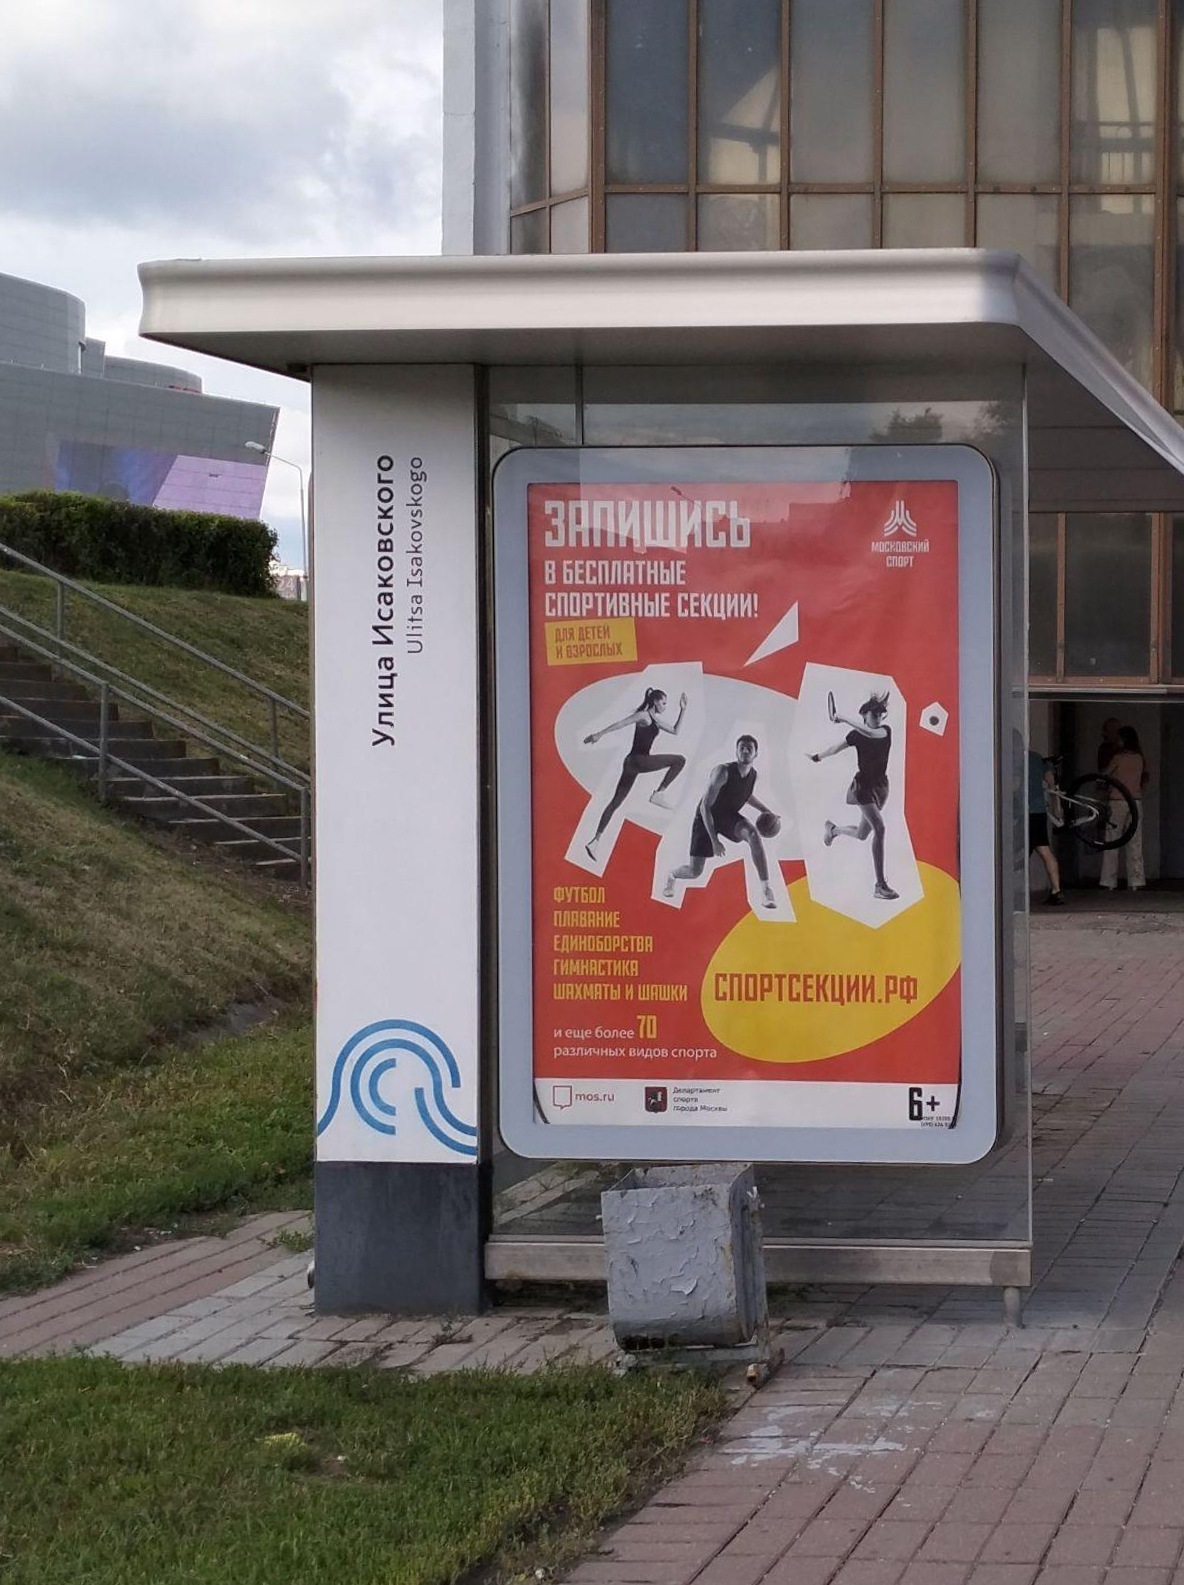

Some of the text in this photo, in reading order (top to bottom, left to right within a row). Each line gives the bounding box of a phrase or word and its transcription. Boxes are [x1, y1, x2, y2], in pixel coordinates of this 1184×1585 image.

[545, 500, 751, 548] ЗАПИШИСЬ
[871, 538, 930, 553] МОСКОВСКИЙ
[406, 457, 427, 654] Ulitsa Isakovskogo
[886, 555, 914, 568] СПОРТ
[545, 560, 687, 585] В БЕСПЛАТНЫЕ
[372, 455, 398, 747] Улица Исаковского
[545, 592, 759, 620] СПОРТИВНЫЕ СЕКЦИИ!
[555, 625, 610, 643] ДЛЯ ДЕТЕЙ
[556, 642, 623, 659] И ВЗРОСЛЫХ
[554, 887, 605, 904] ФУТБОЛ
[554, 911, 621, 928] ПЛАВАНИЕ
[554, 935, 653, 953] ЕДИНОБОРСТВА
[553, 959, 639, 976] ГИМНАСТИКА
[553, 983, 688, 1001] ШАХМАТЫ И ШАШКИ
[714, 973, 918, 1006] СПОРТСЕКЦИИ.РФ
[554, 1015, 657, 1040] и еще более 70
[554, 1047, 717, 1061] различных видов спорта
[575, 1092, 614, 1102] mos.ru
[909, 1087, 940, 1120] 6+
